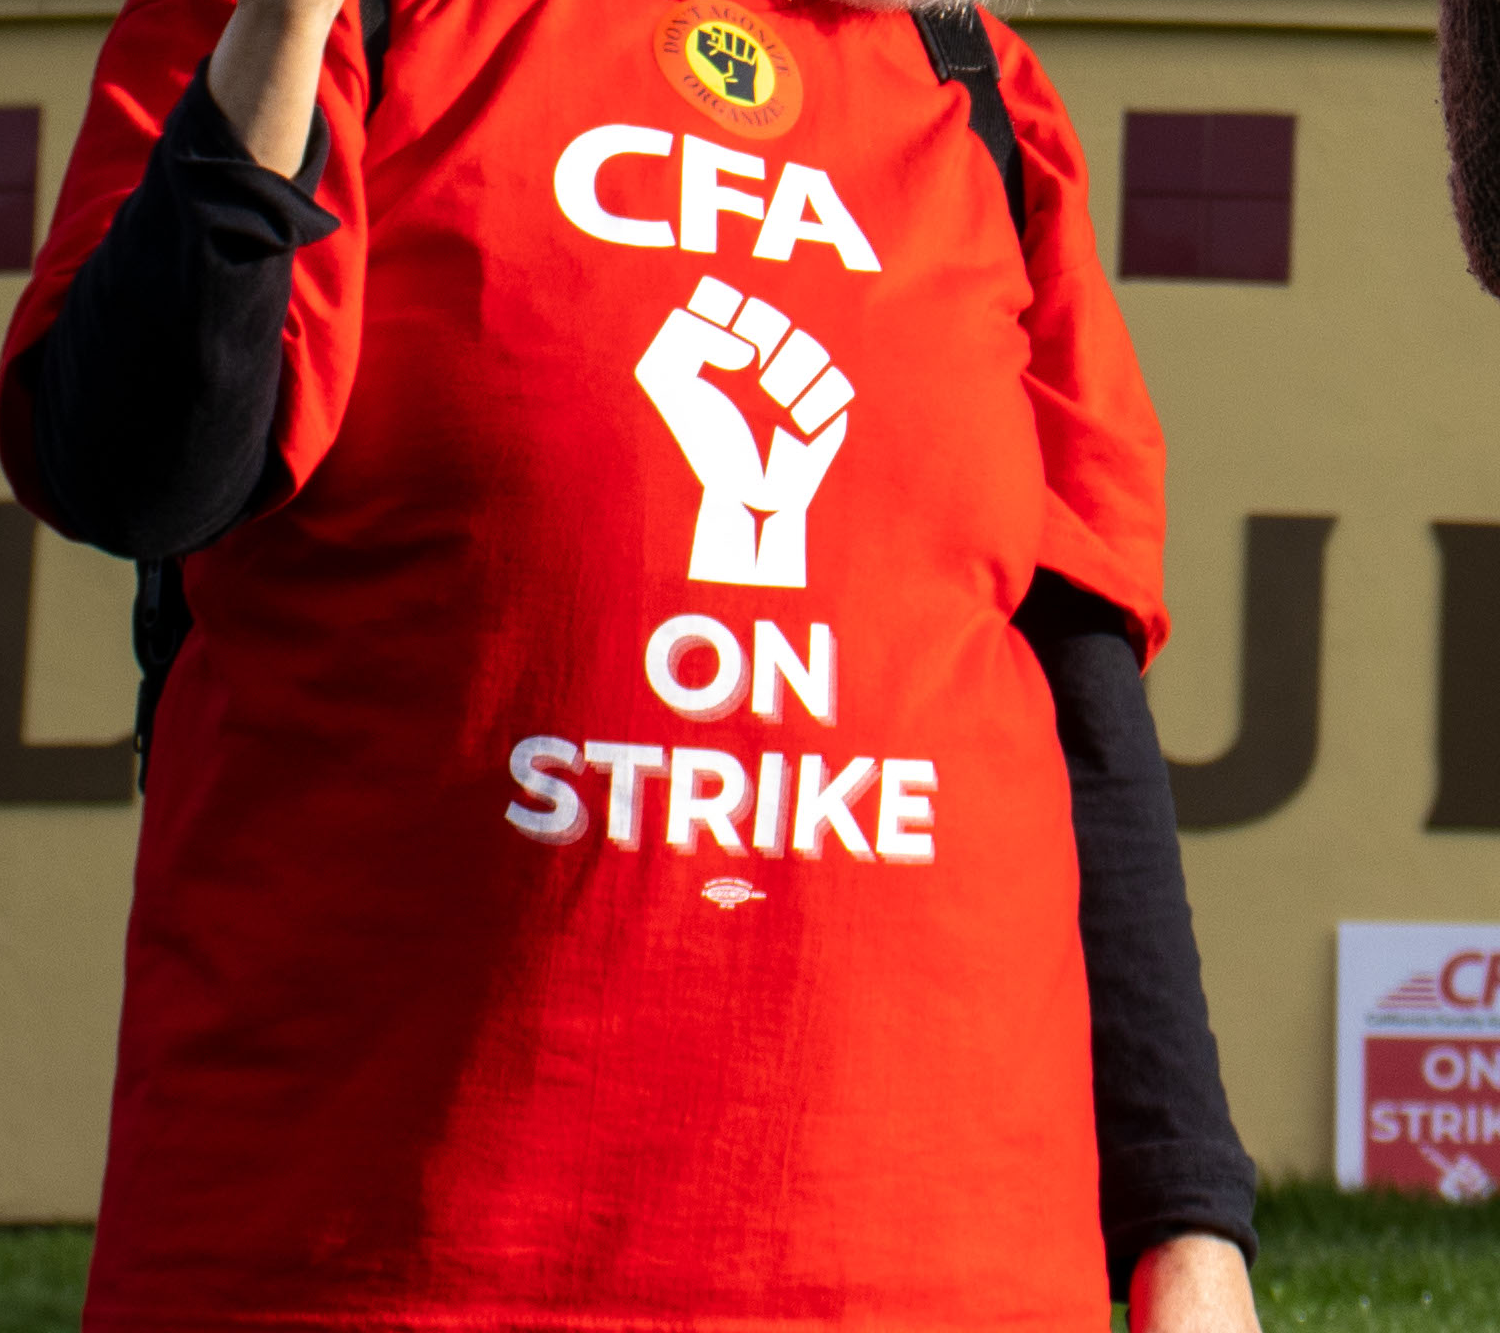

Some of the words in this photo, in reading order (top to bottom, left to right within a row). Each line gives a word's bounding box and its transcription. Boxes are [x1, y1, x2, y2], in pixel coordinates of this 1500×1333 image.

[552, 123, 883, 273] CFA
[643, 613, 838, 726] ON
[505, 735, 938, 866] STRIKE
